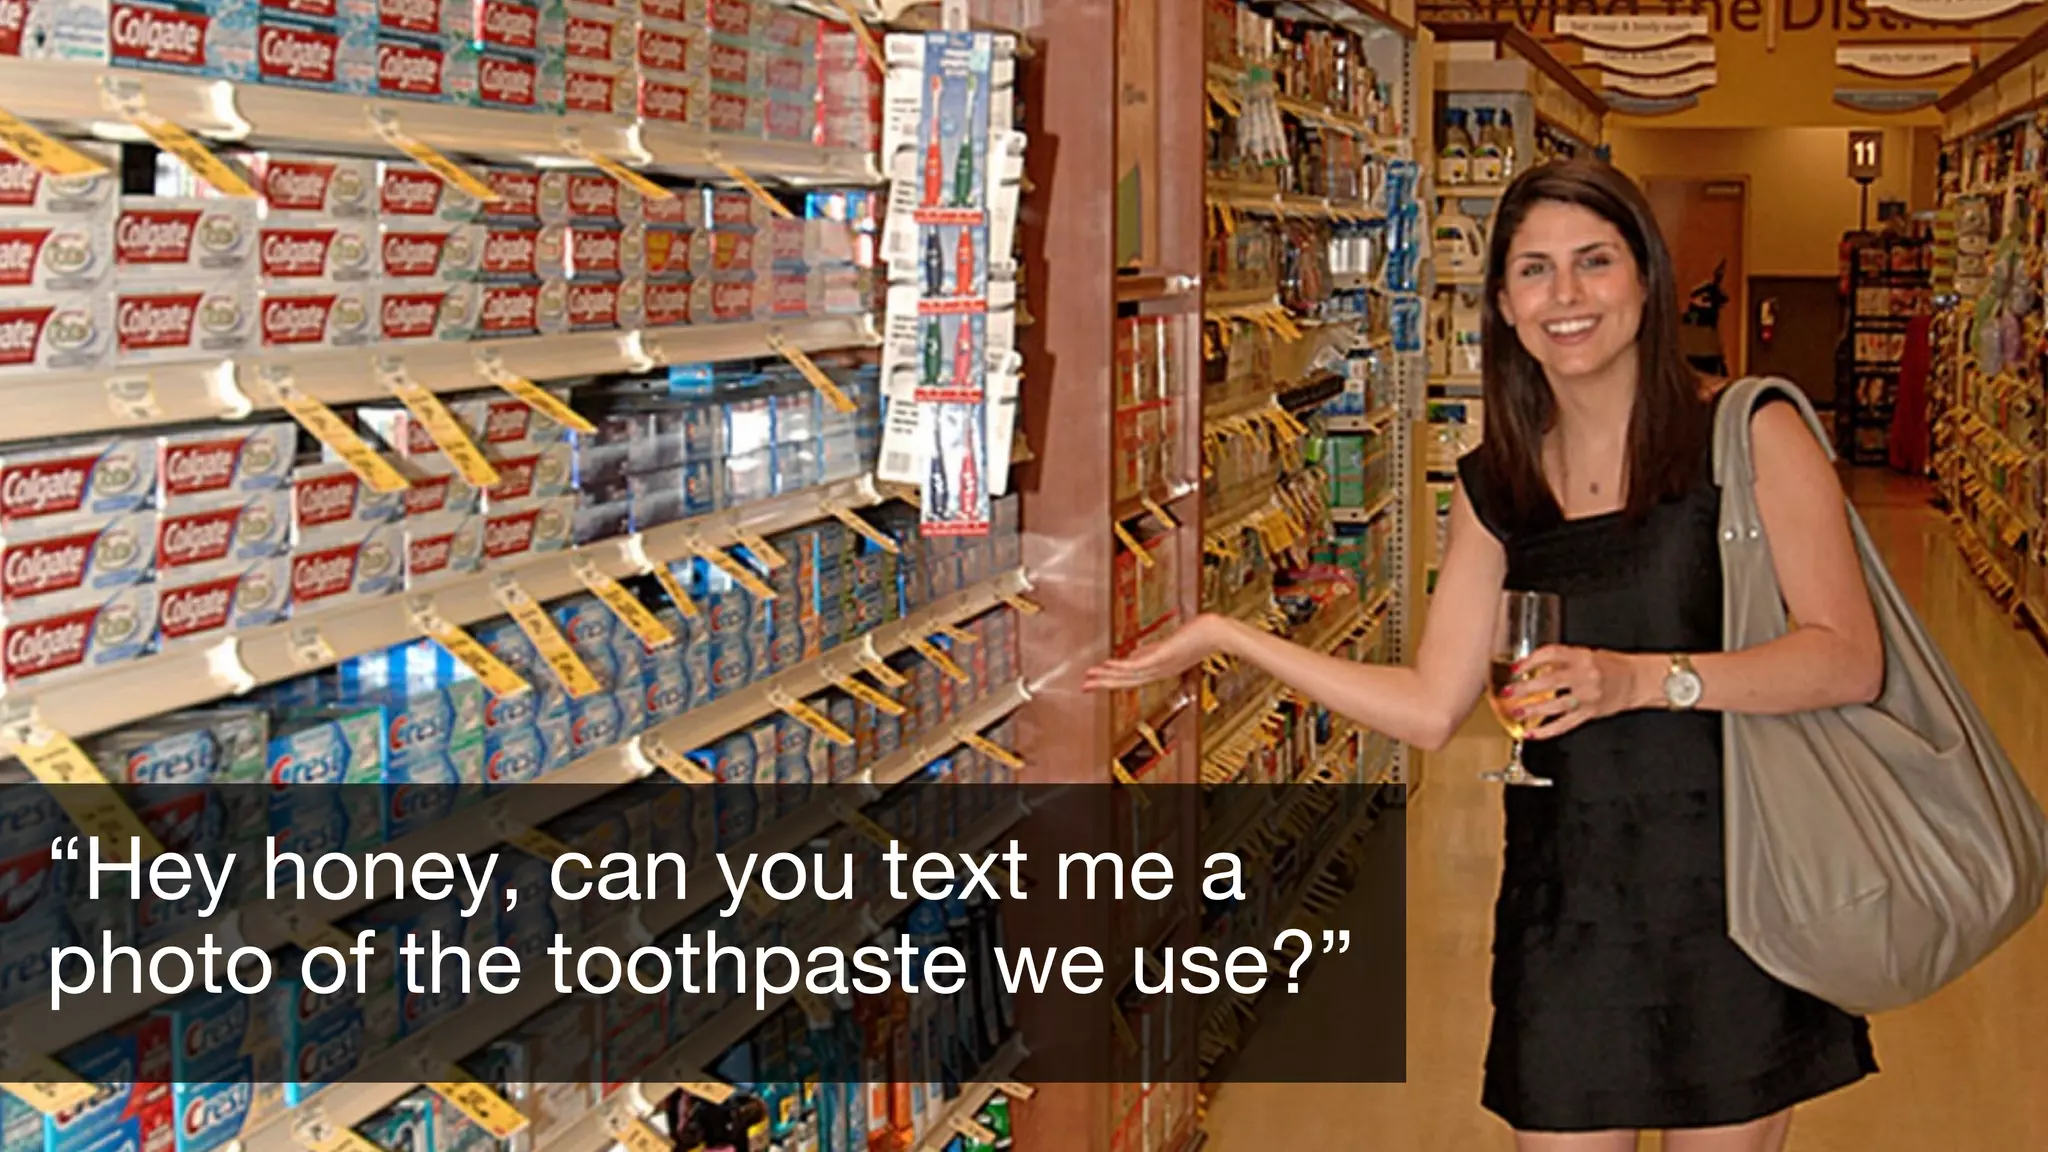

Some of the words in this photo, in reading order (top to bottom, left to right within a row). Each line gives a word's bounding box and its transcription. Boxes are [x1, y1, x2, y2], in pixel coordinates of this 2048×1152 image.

[112, 7, 201, 57] Colgate
[262, 30, 332, 76] Colgate
[1854, 140, 1876, 166] 11
[118, 216, 190, 256] Colgate
[119, 301, 191, 342] Colgate
[167, 449, 232, 485] Colgate
[3, 468, 84, 508] Colgate
[164, 520, 231, 555] Colgate
[4, 545, 85, 586] Colgate
[161, 588, 229, 625] Colgate
[8, 620, 85, 665] Colgate
[127, 741, 209, 784] Crest
[270, 741, 340, 792] Crest
[184, 1084, 250, 1137] Crest
